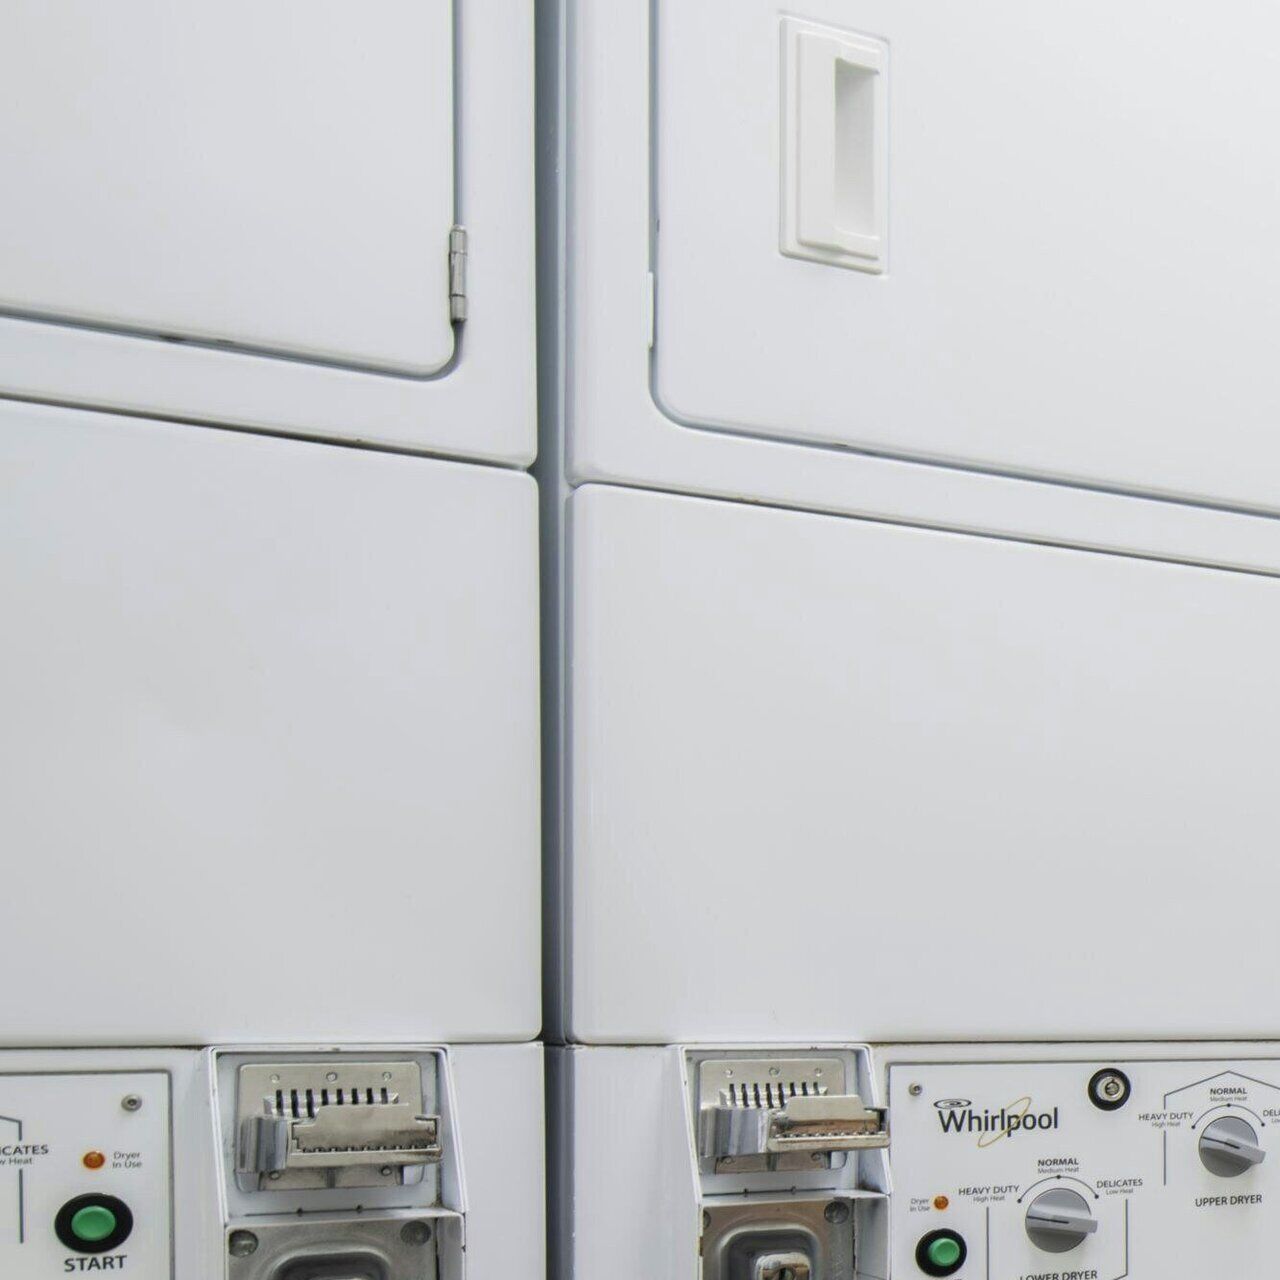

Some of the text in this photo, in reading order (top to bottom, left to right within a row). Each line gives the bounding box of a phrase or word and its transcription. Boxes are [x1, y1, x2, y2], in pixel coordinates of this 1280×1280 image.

[1210, 1088, 1248, 1096] NORMAL
[1138, 1112, 1194, 1121] HEAVY DUTY
[938, 1107, 1058, 1137] Whirlpool
[113, 1151, 141, 1161] Dryer
[9, 1157, 33, 1165] Heat
[124, 1160, 143, 1168] Use
[1037, 1158, 1079, 1167] NORMAL
[1096, 1179, 1143, 1189] DELICATES
[958, 1184, 1020, 1196] HEAVY DUTY
[973, 1194, 1006, 1203] High Heat
[1195, 1195, 1263, 1208] UPPER DRYER
[64, 1255, 128, 1272] START
